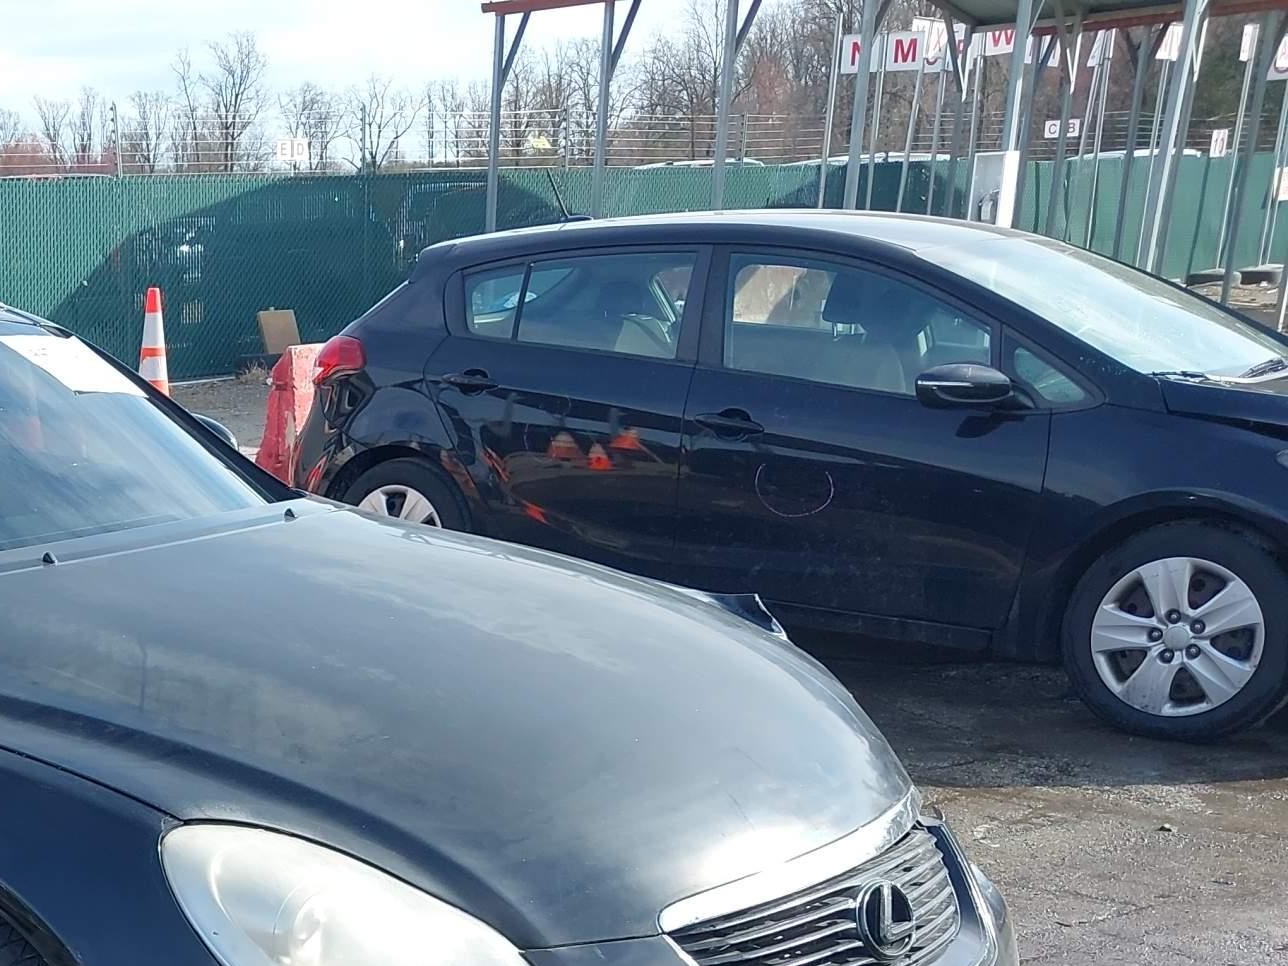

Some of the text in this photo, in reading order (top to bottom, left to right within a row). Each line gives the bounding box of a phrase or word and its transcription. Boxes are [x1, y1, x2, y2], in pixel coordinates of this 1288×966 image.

[991, 28, 1016, 48] W
[893, 38, 918, 63] M
[1048, 123, 1057, 135] C
[280, 142, 289, 156] E
[296, 142, 305, 156] D
